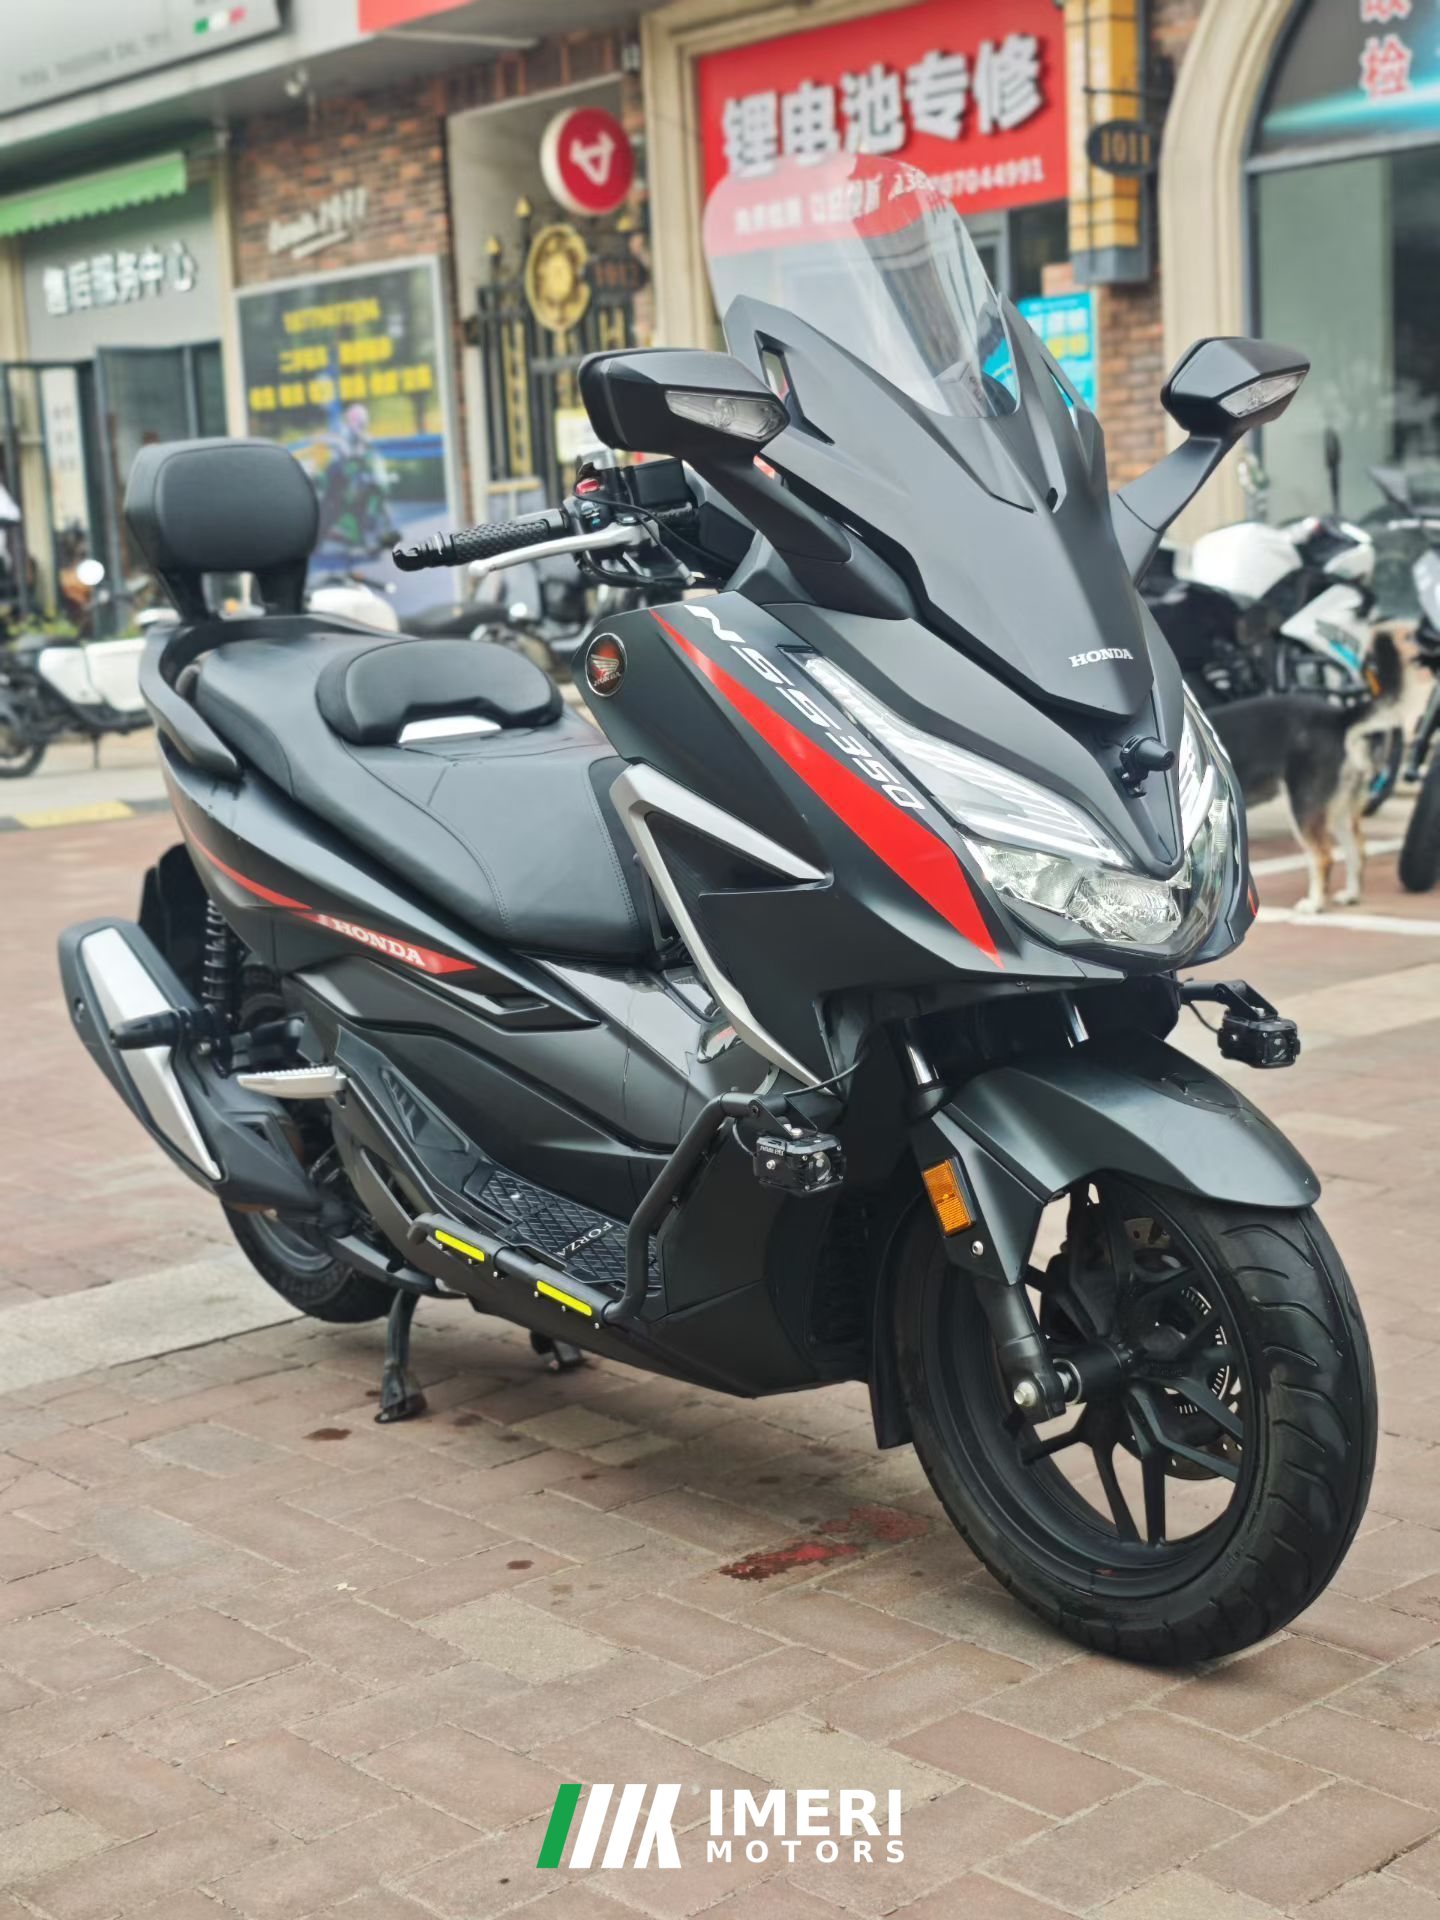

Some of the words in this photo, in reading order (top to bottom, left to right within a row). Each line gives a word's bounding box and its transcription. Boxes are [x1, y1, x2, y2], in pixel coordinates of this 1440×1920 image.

[722, 33, 1044, 178] 锂电池专修
[1102, 130, 1151, 164] 1011
[44, 240, 197, 316] 售后服务中心
[1068, 647, 1134, 668] HONDA
[330, 918, 426, 967] HONDA
[552, 1221, 614, 1257] FORZA
